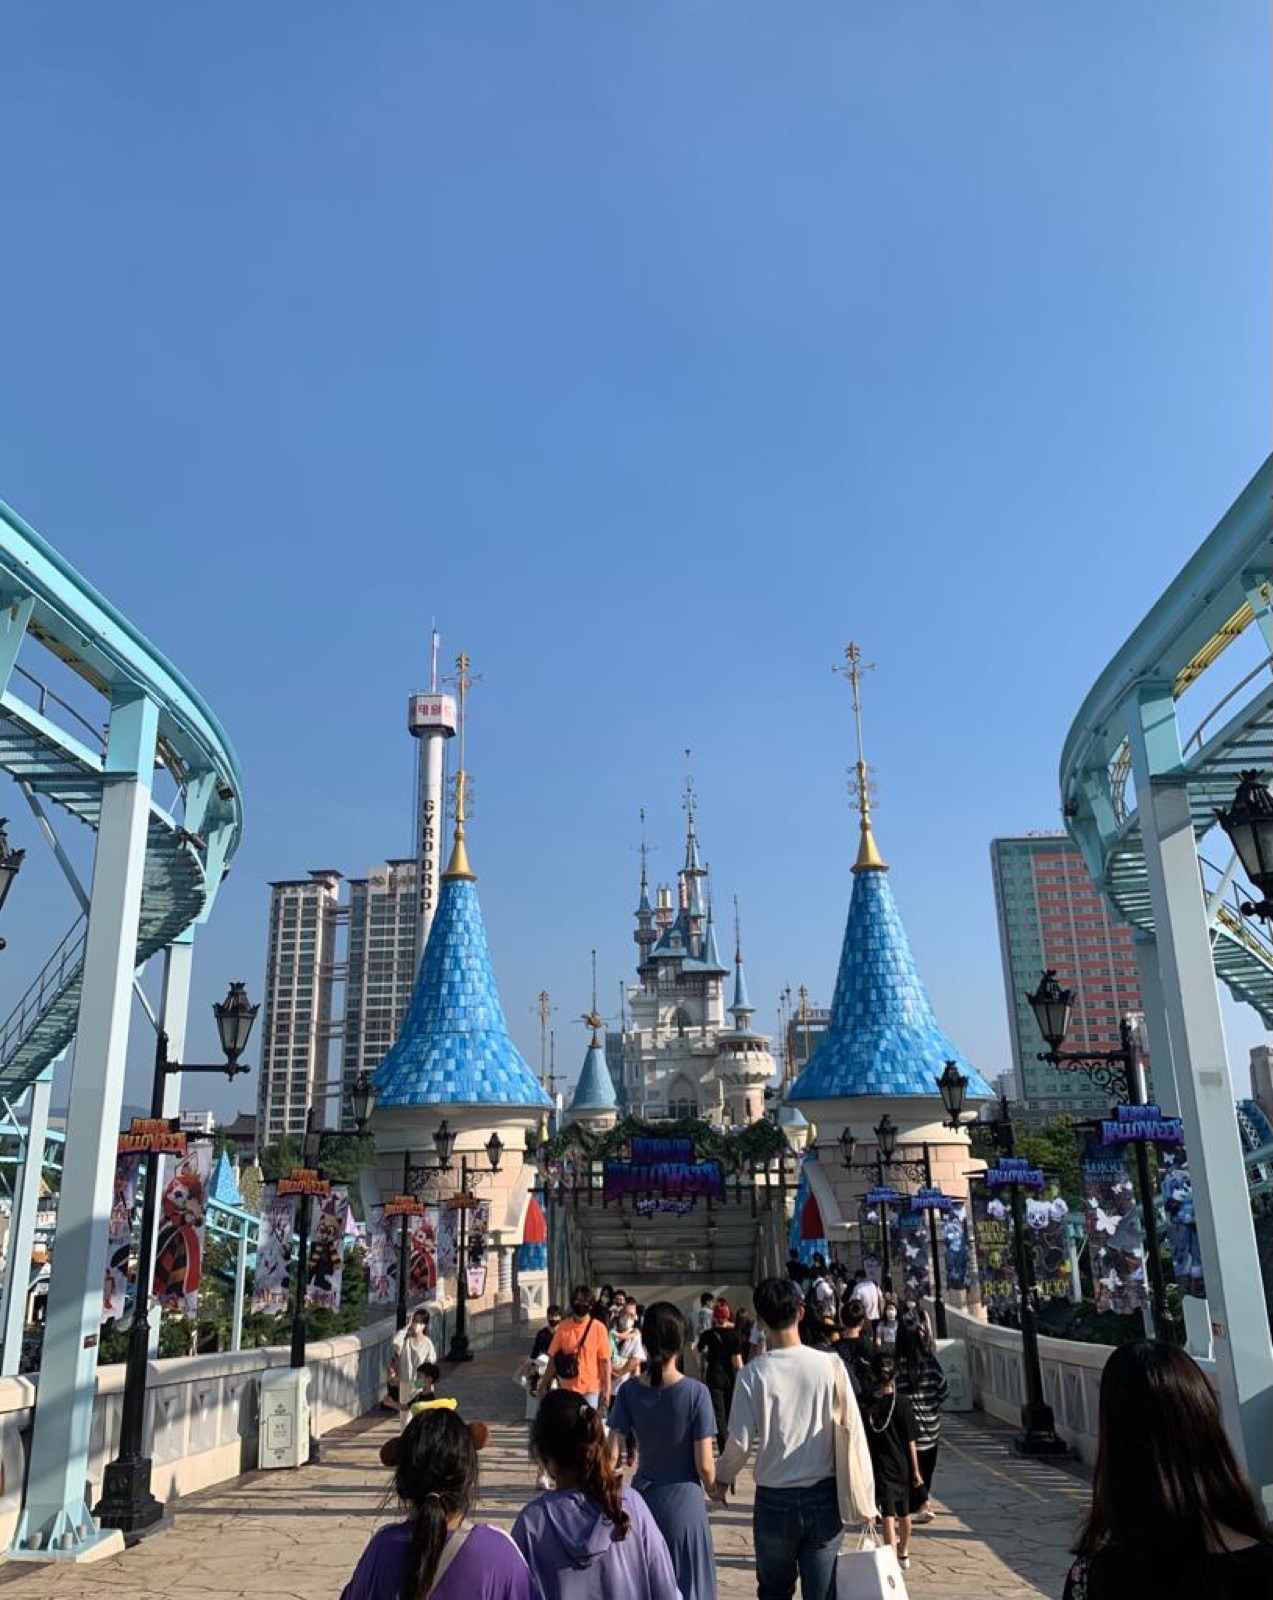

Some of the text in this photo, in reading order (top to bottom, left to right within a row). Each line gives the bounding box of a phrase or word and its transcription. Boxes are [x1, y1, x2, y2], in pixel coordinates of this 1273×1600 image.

[420, 799, 435, 914] GYRO DROP
[1102, 1118, 1185, 1146] HALLOWEEN
